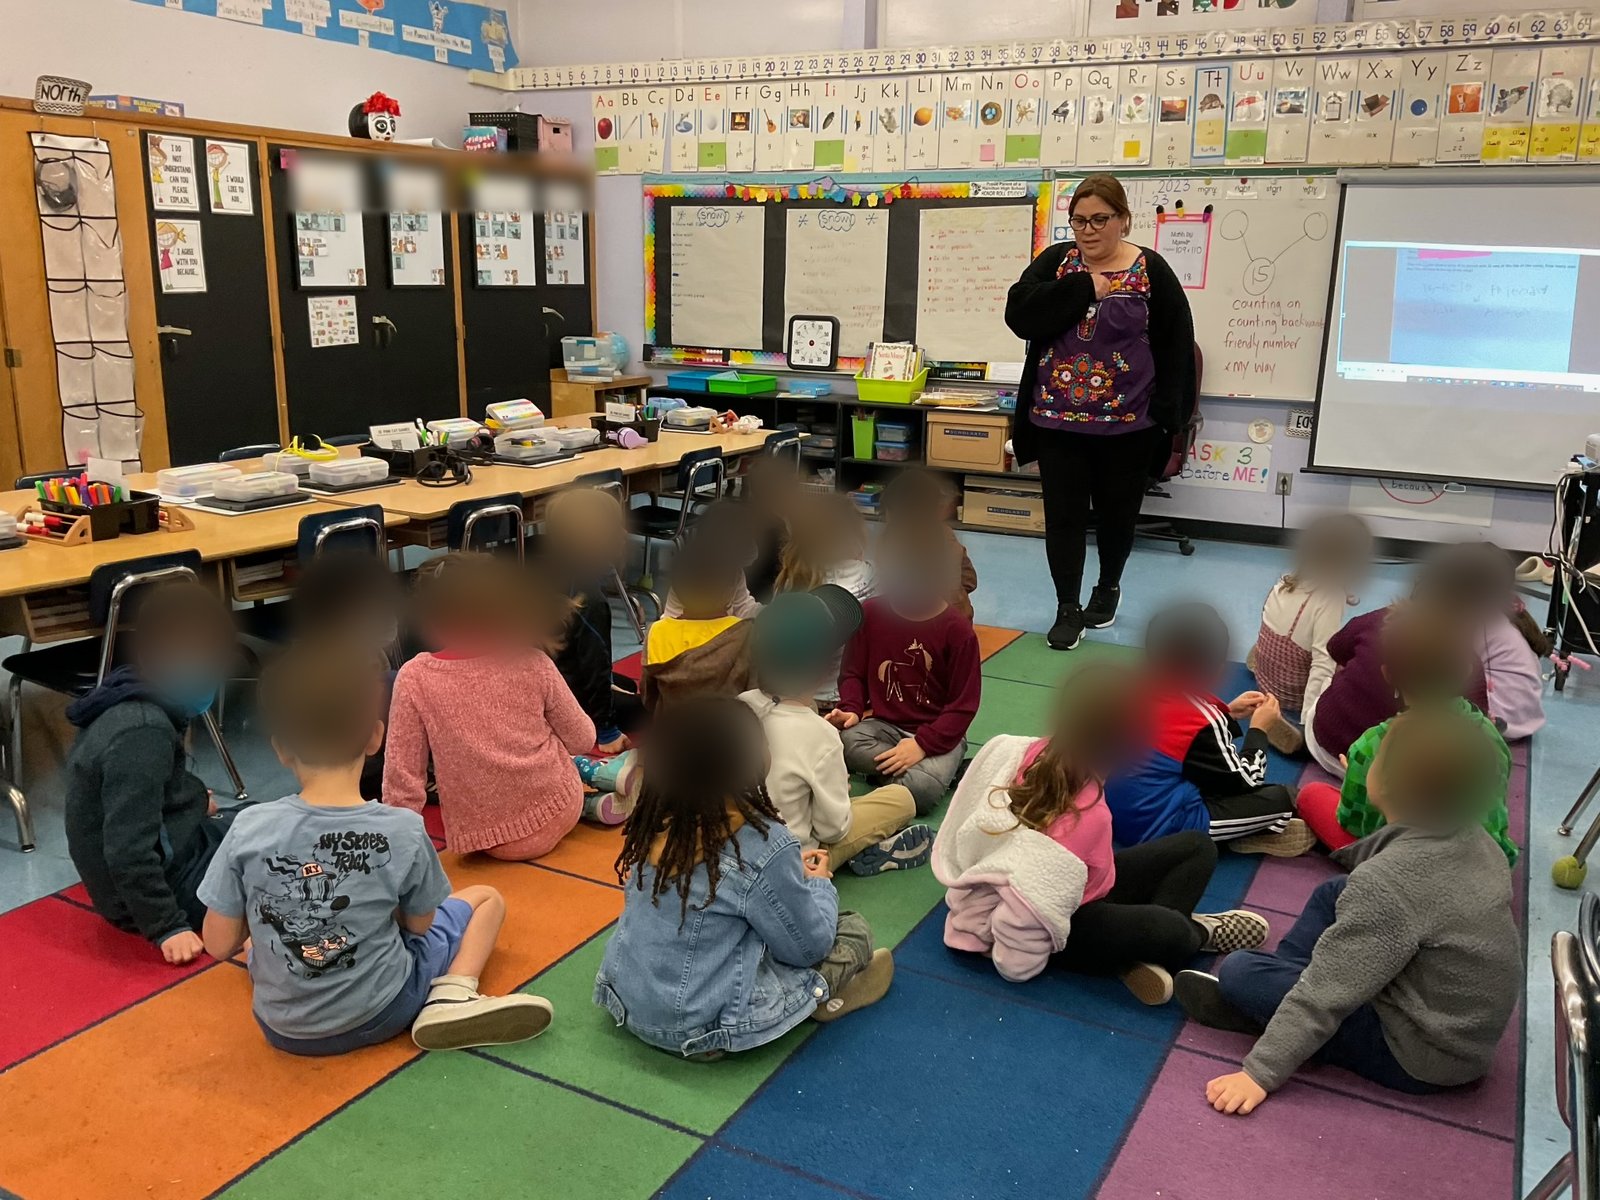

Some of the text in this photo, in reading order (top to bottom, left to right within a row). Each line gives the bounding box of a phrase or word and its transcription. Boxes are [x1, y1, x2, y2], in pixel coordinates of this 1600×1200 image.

[521, 19, 1591, 82] 1 2 3 4 5 6 7 8 9 10 11 12 13 14 15 16 17 18 19 20 21 22 23 24 25 26 27 28 29 30 31 32 33 34 35 36 37 38 39 40 41 42 43 44 45 46 47 48 49 50 51 52 53 54 55 56 57 58 59 60 61 62 63 64
[466, 143, 481, 151] Toys
[468, 134, 490, 144] Fidget
[164, 165, 191, 173] UNDERSTAND
[172, 186, 188, 194] PLEASE
[1252, 264, 1269, 286] 15
[1232, 295, 1300, 317] counting on
[1228, 314, 1277, 335] counting
[1224, 331, 1301, 358] friendly number
[1237, 447, 1253, 465] 3
[1180, 462, 1230, 481] Before
[304, 864, 320, 875] NY
